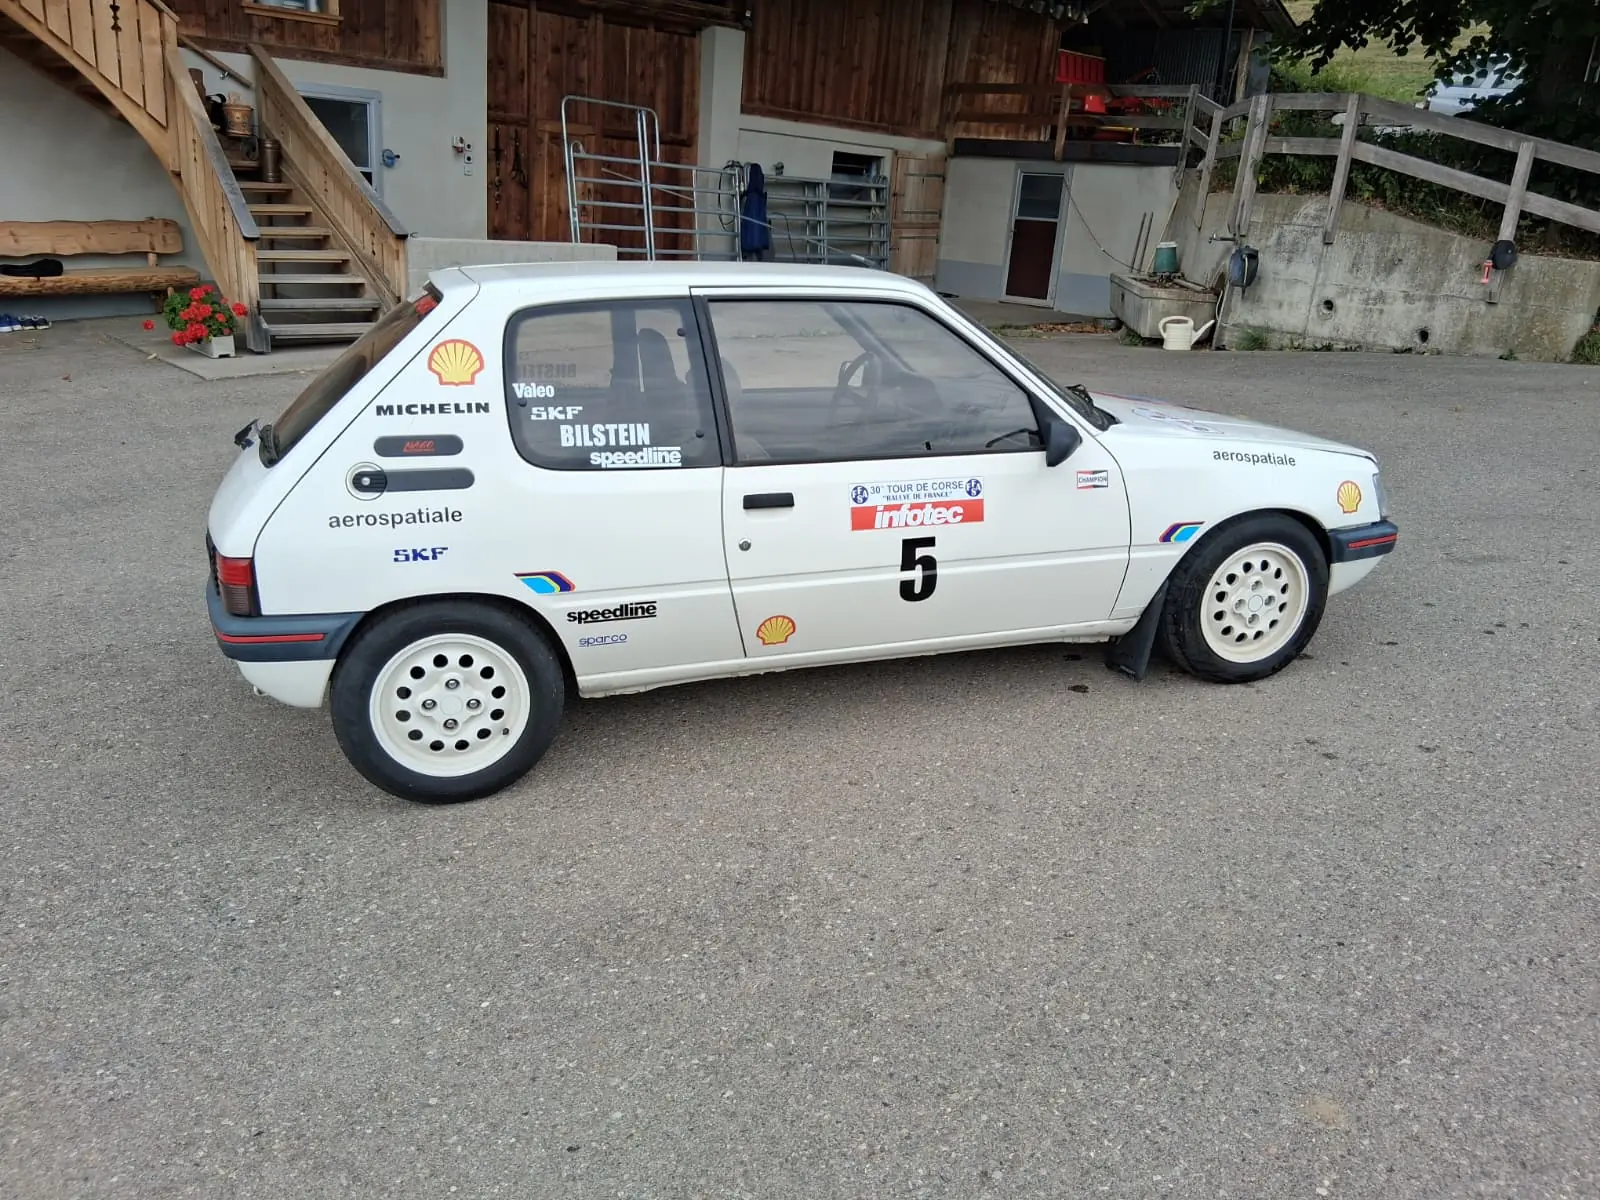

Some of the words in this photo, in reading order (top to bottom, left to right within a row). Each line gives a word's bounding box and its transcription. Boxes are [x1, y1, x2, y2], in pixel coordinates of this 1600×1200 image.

[512, 383, 555, 398] Valeo
[376, 402, 490, 416] MICHELIN
[530, 406, 583, 420] SKF
[560, 423, 650, 447] BILSTEIN
[590, 447, 682, 468] speedline
[1213, 449, 1297, 467] aerospatiale
[888, 484, 913, 493] TOUR
[916, 482, 929, 492] DE
[931, 480, 964, 490] CORSE
[328, 507, 463, 529] aerospatiale
[874, 503, 964, 529] infotec
[393, 547, 449, 563] SKF
[899, 536, 938, 602] 5
[566, 600, 657, 624] speedline
[579, 633, 628, 647] sparco
